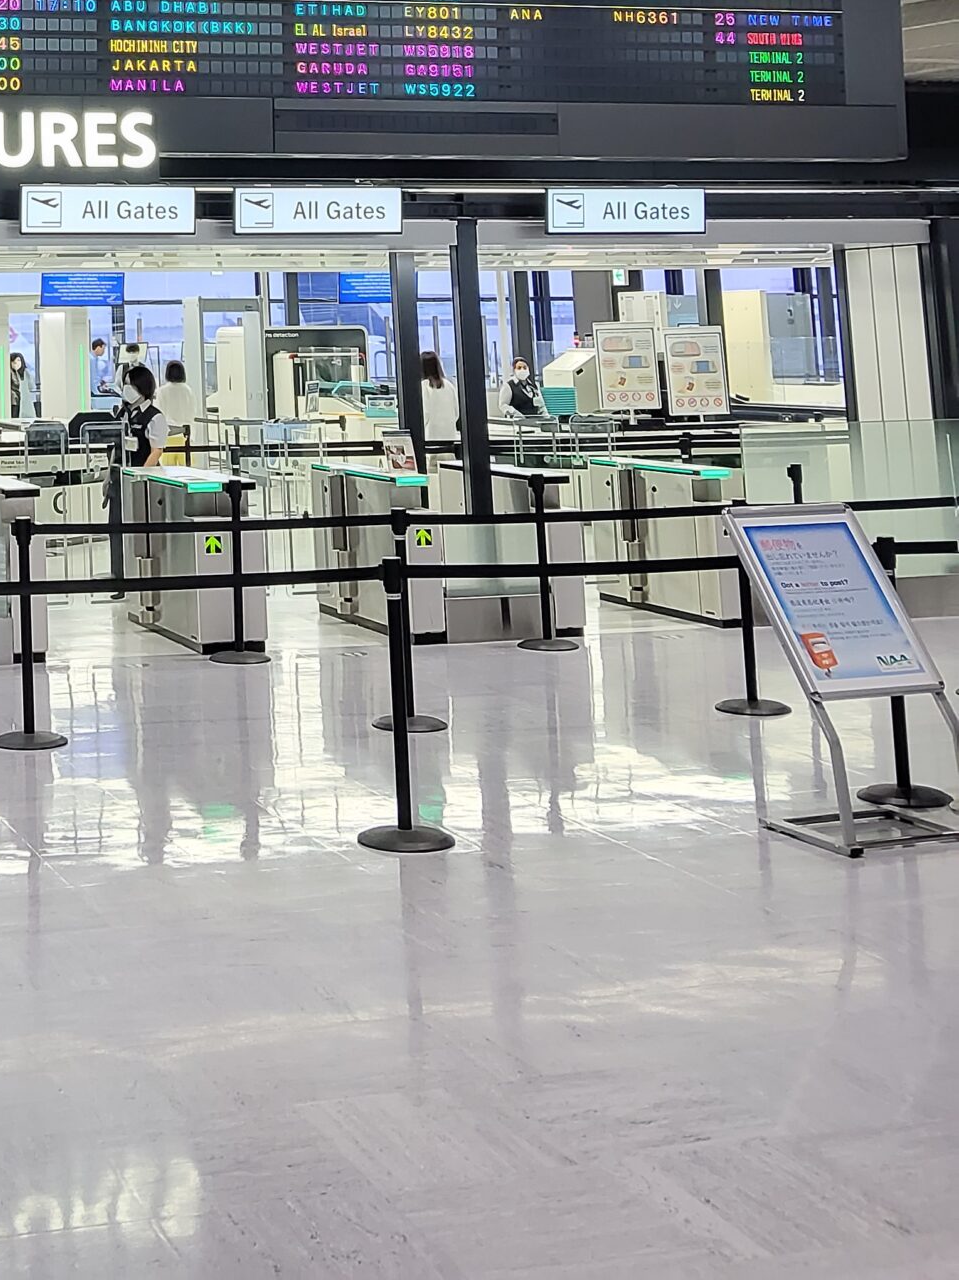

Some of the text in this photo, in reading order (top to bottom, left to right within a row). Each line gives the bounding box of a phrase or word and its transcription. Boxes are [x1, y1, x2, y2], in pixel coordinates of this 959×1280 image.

[614, 11, 676, 24] NH6361
[113, 60, 196, 72] JAKARTA
[405, 84, 474, 96] WS5922
[82, 200, 179, 220] All Gates
[293, 201, 386, 220] All Gates
[603, 202, 690, 220] All Gates
